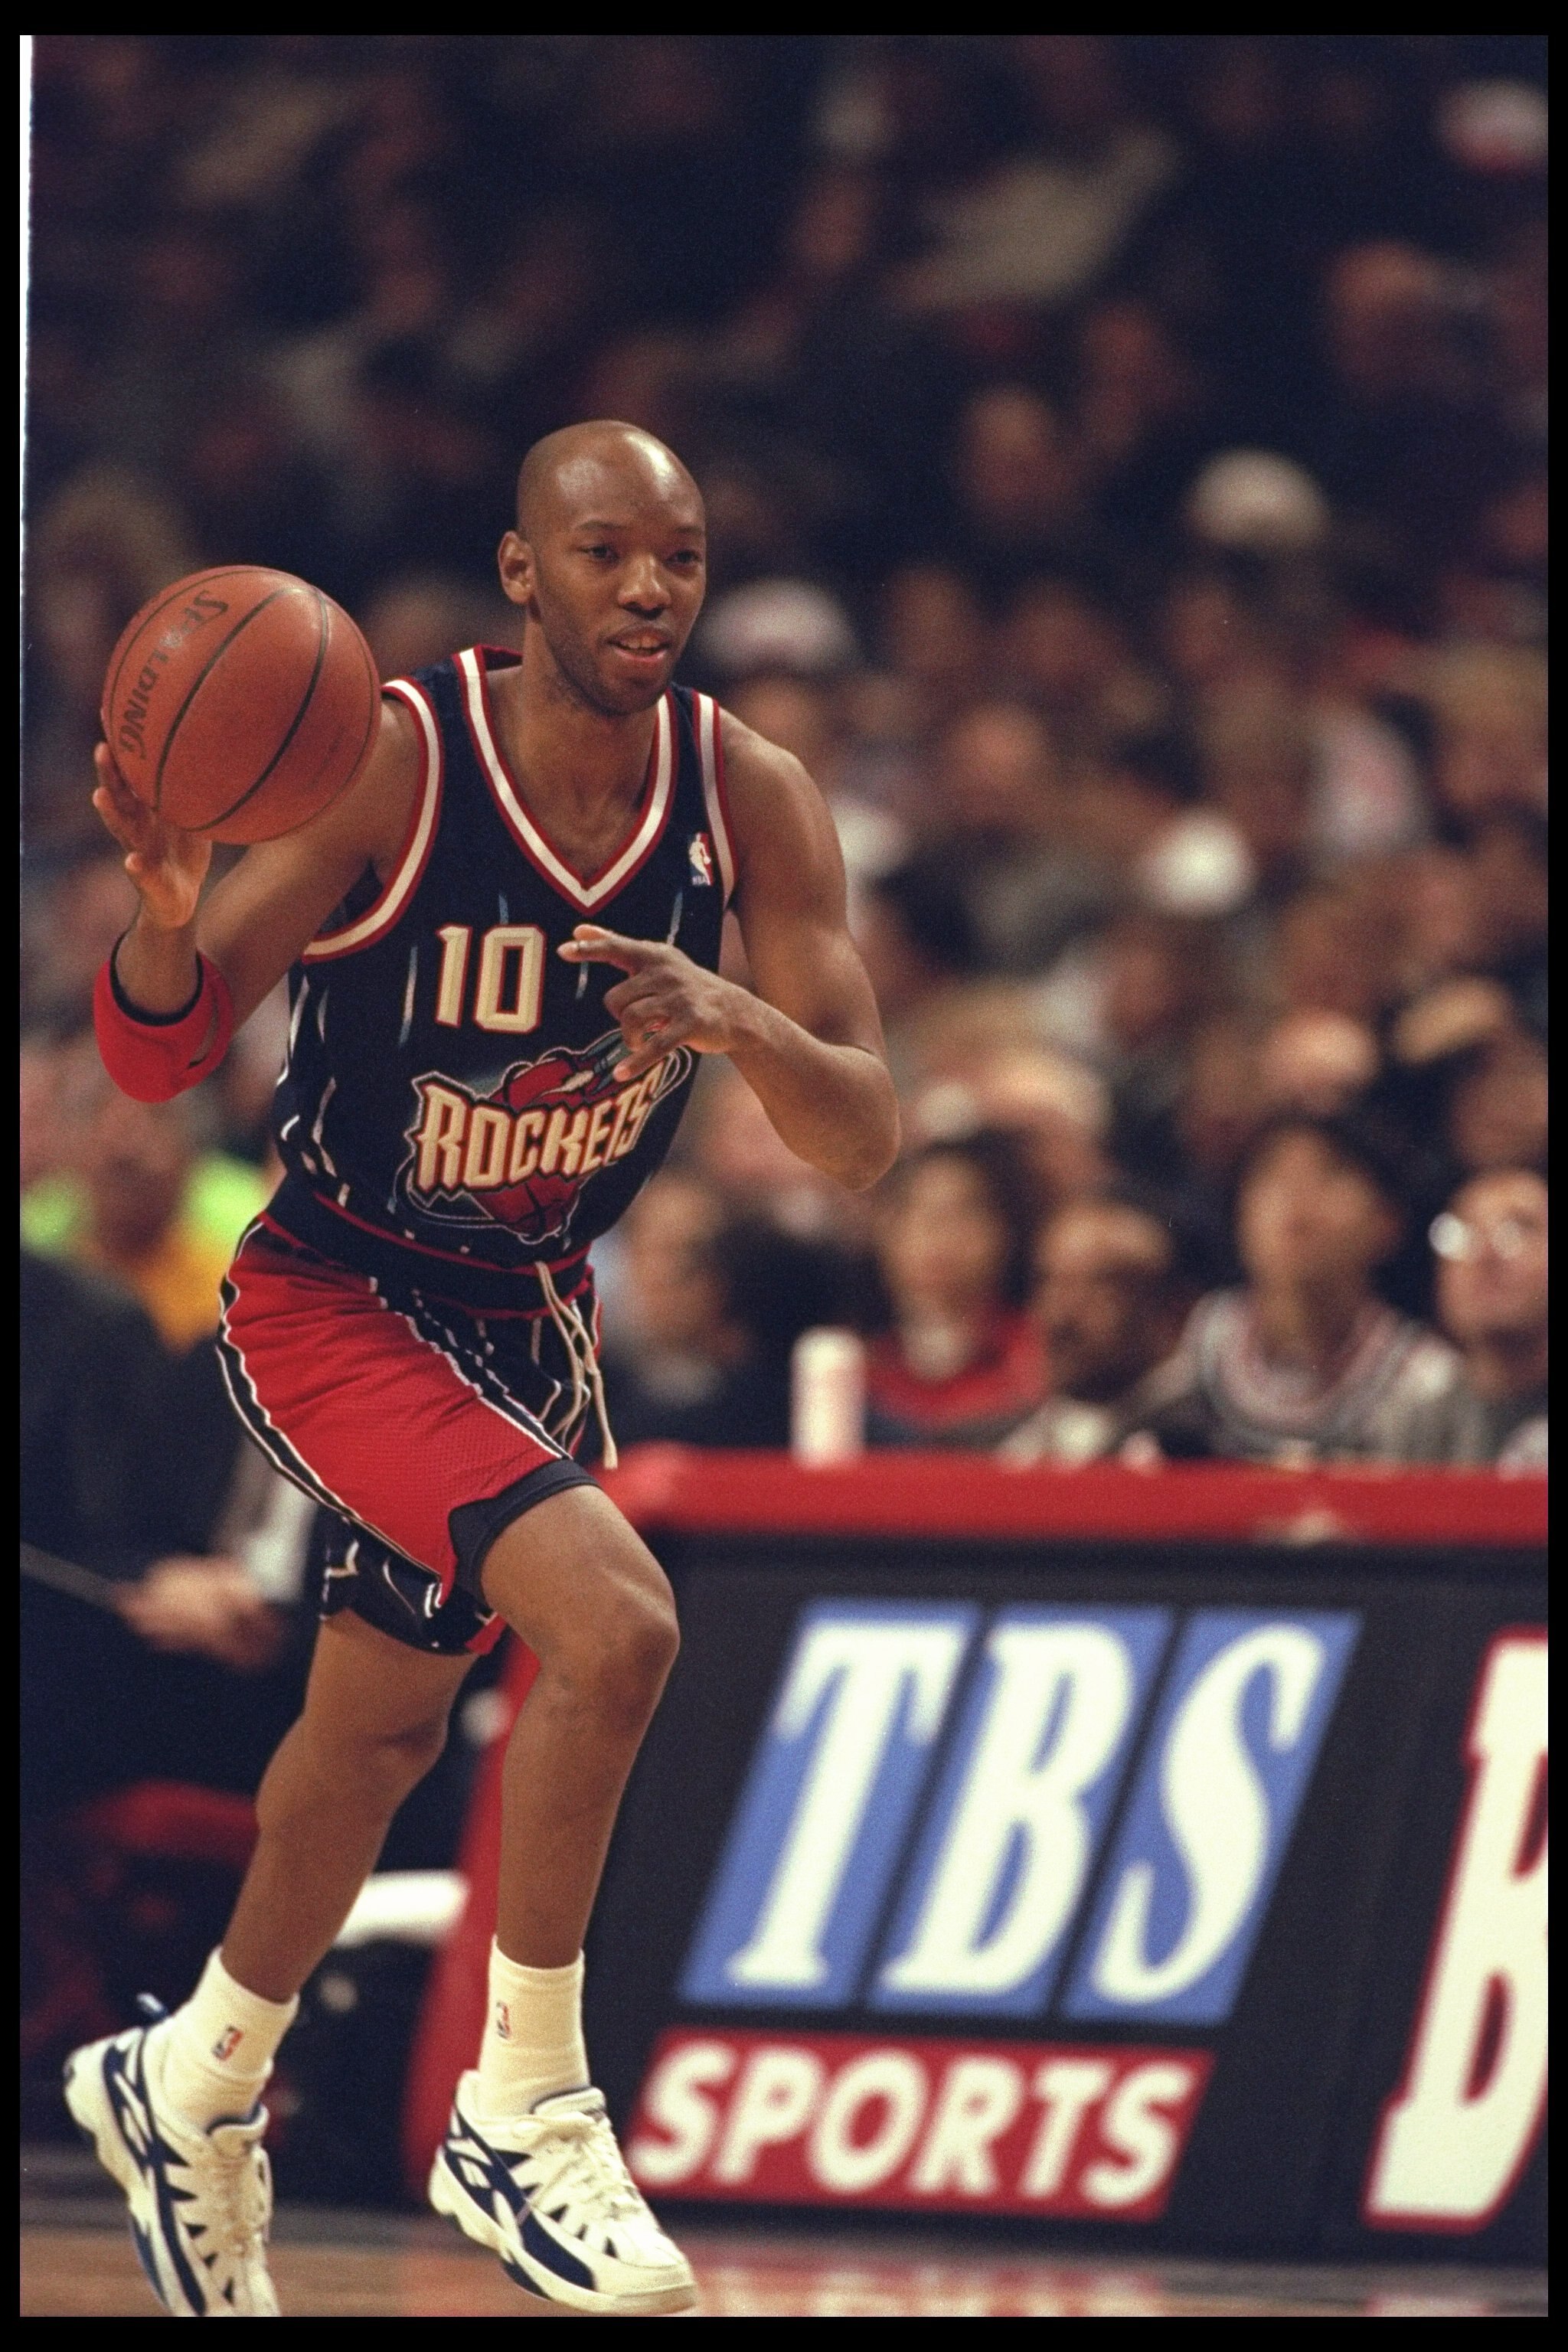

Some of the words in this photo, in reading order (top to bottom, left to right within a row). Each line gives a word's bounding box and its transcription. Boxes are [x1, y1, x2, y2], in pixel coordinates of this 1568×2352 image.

[435, 924, 547, 1034] 10
[414, 1058, 665, 1191] ROCKETS
[726, 1617, 1326, 2004] TBS
[628, 2037, 1196, 2207] SPORTS
